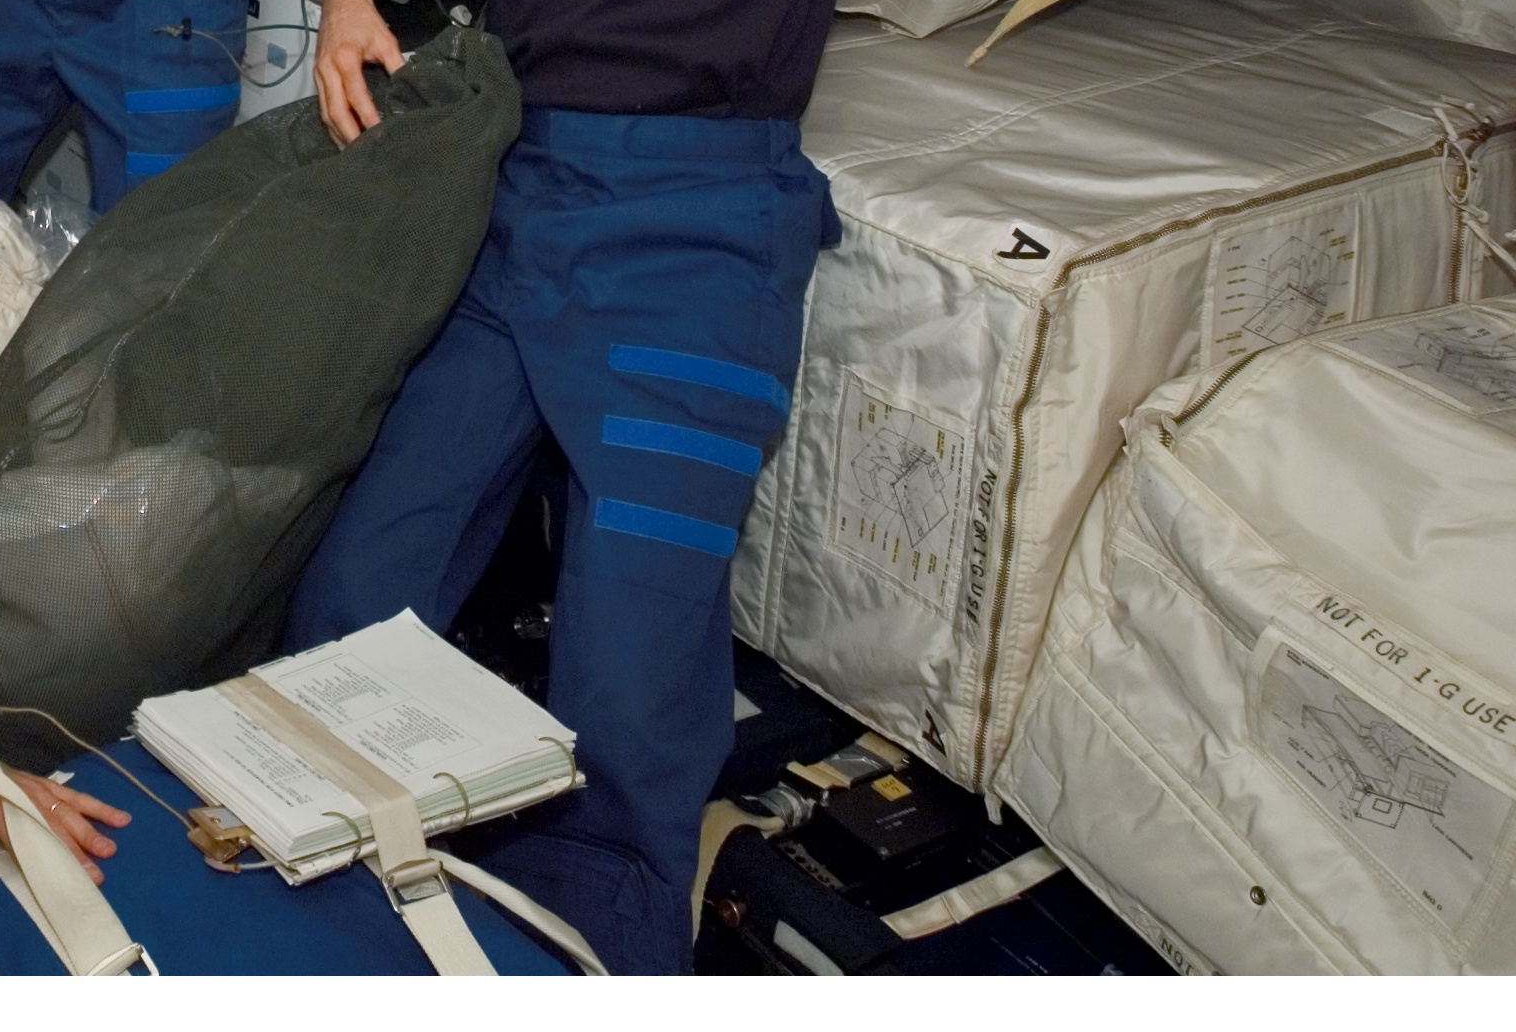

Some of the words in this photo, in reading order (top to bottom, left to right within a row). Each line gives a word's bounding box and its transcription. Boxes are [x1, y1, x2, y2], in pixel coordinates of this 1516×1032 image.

[998, 228, 1051, 262] A
[978, 469, 997, 507] NOT
[974, 506, 990, 544] FOR
[1315, 596, 1364, 629] NOT
[1360, 627, 1409, 666] FOR
[1462, 697, 1515, 735] USE
[923, 710, 948, 758] A
